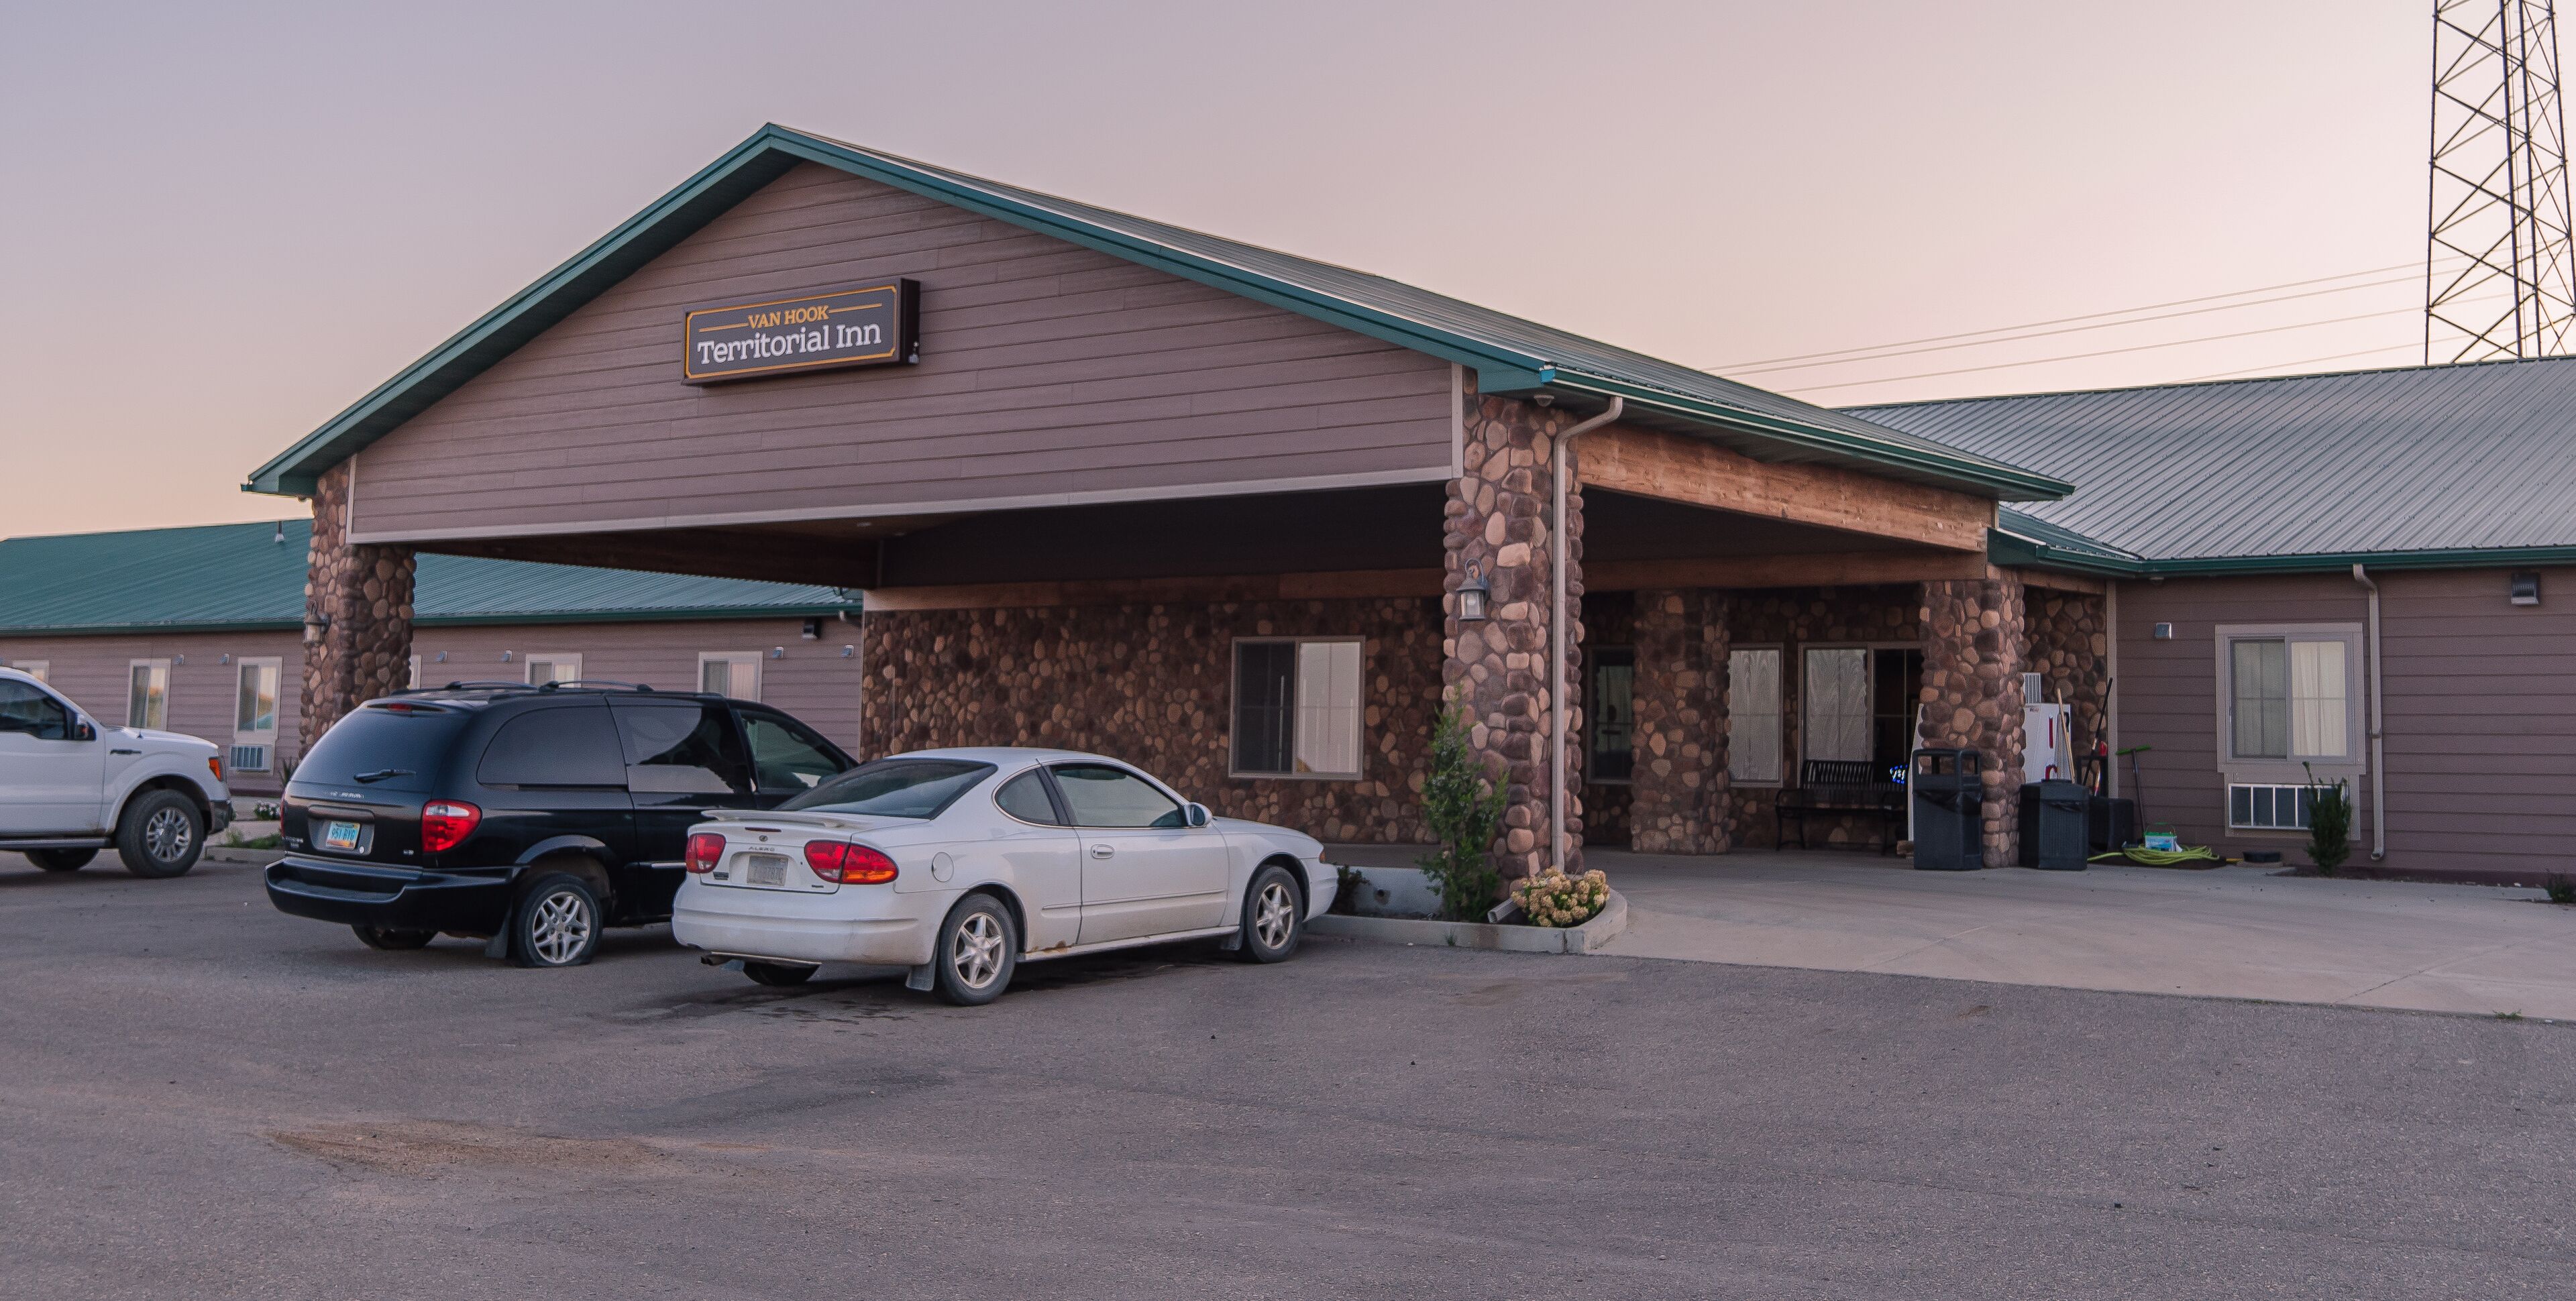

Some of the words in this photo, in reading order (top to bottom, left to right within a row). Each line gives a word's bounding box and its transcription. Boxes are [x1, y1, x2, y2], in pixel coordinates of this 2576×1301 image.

[748, 310, 780, 329] VAN
[784, 305, 829, 322] HOOK
[697, 325, 830, 364] Territorial
[836, 323, 881, 349] Inn
